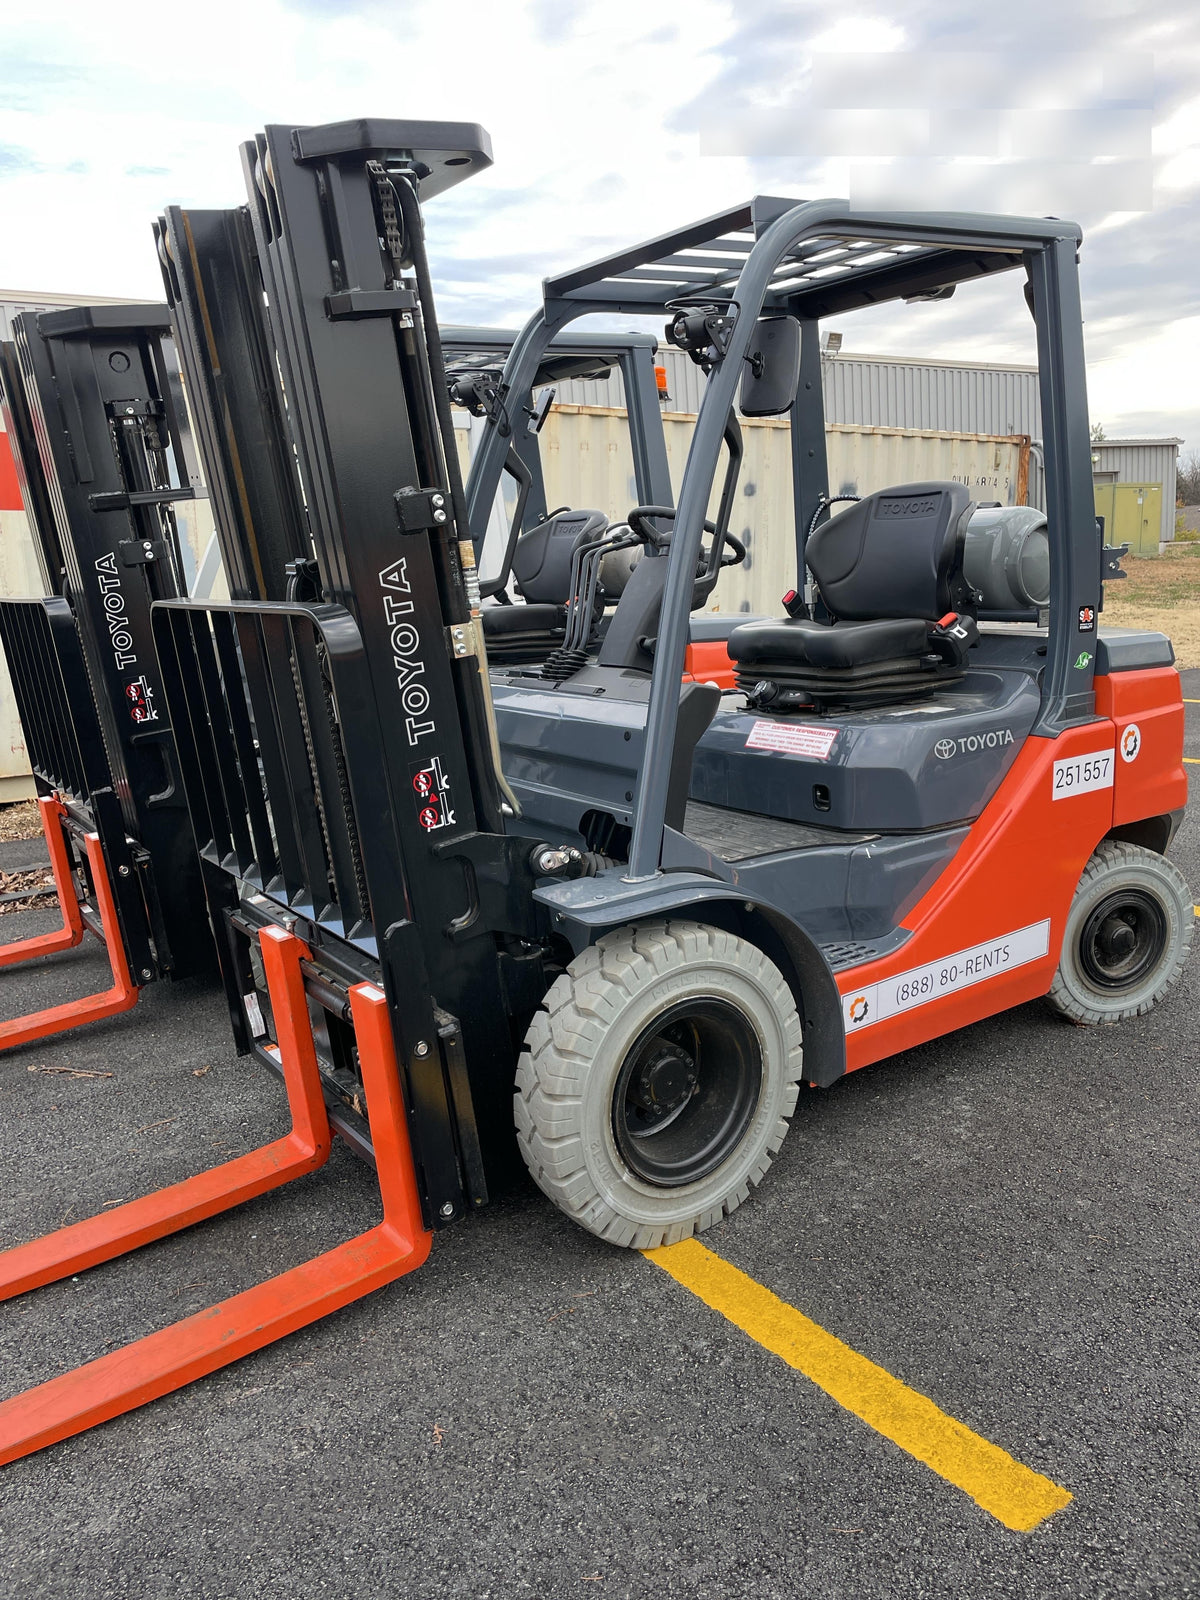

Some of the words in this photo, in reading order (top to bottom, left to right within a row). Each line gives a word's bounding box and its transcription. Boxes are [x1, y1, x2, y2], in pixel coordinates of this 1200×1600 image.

[883, 502, 935, 515] TOYOTA
[95, 552, 137, 670] TOYOTA
[379, 557, 436, 746] TOYOTA
[958, 729, 1014, 753] TOYOTA
[1055, 758, 1110, 788] 251557
[896, 973, 934, 1005] (888)
[939, 945, 1010, 986] 80-RENTS
